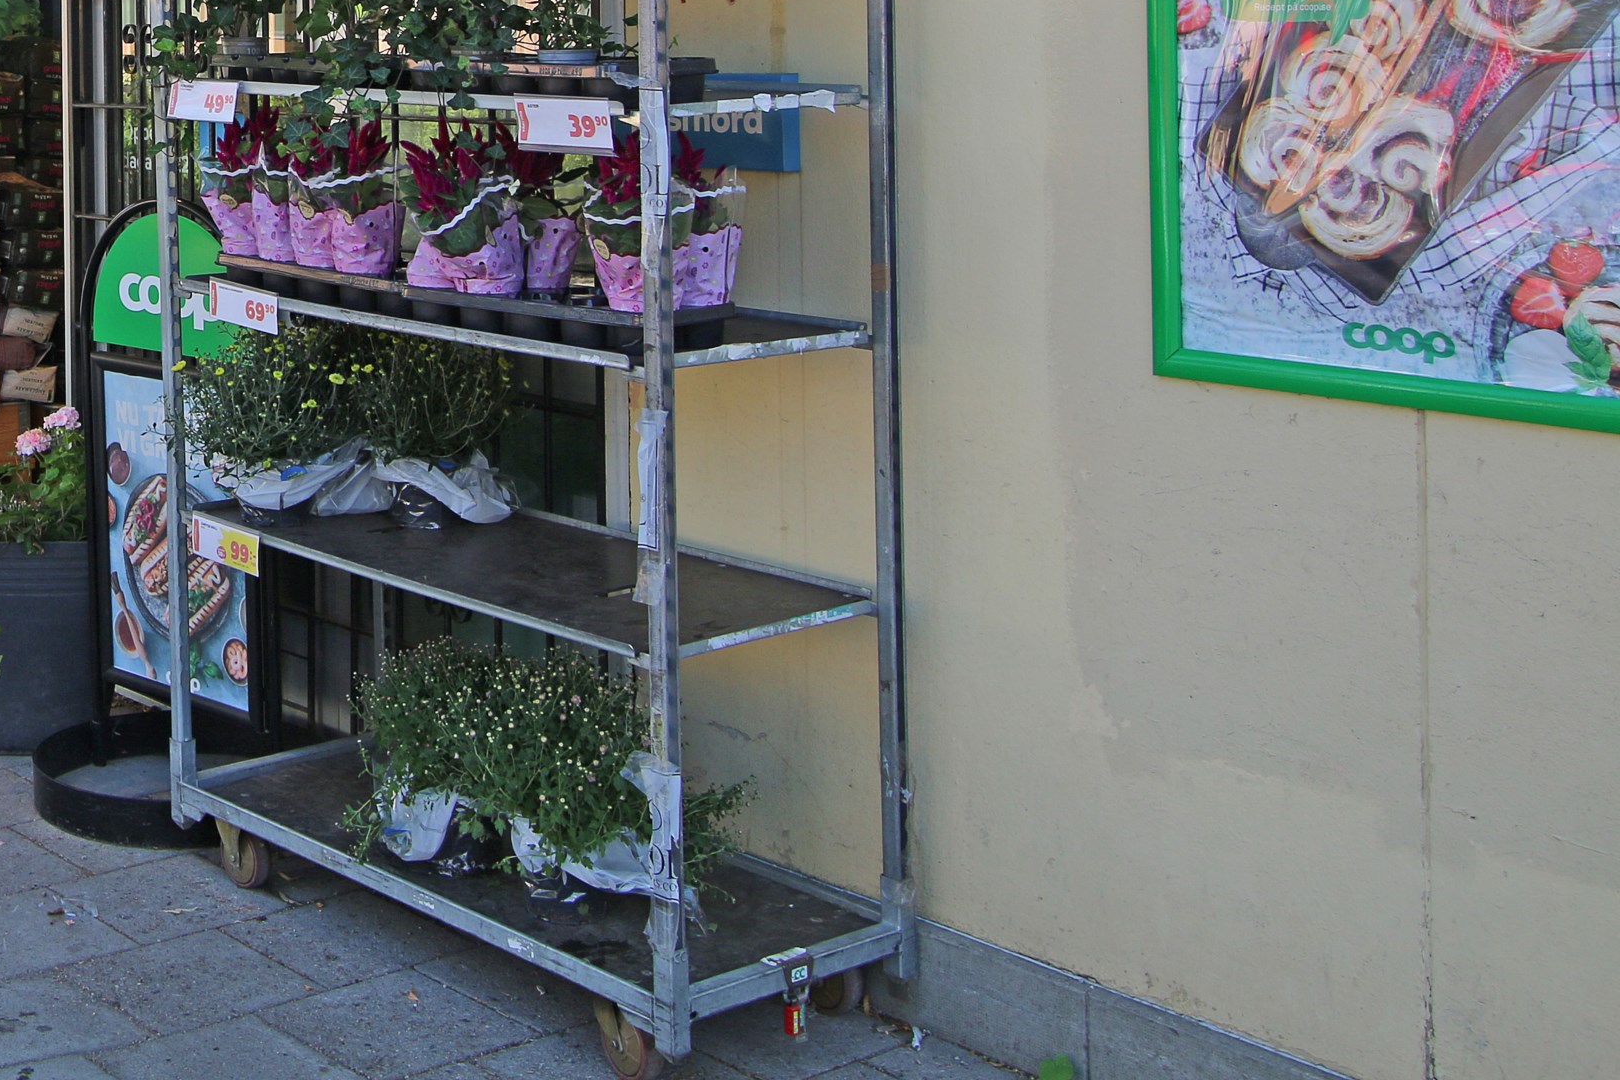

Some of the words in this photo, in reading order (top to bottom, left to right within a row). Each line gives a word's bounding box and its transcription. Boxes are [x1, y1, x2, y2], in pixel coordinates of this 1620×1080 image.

[1342, 321, 1456, 363] coop
[116, 400, 139, 425] NU
[118, 431, 135, 454] VI
